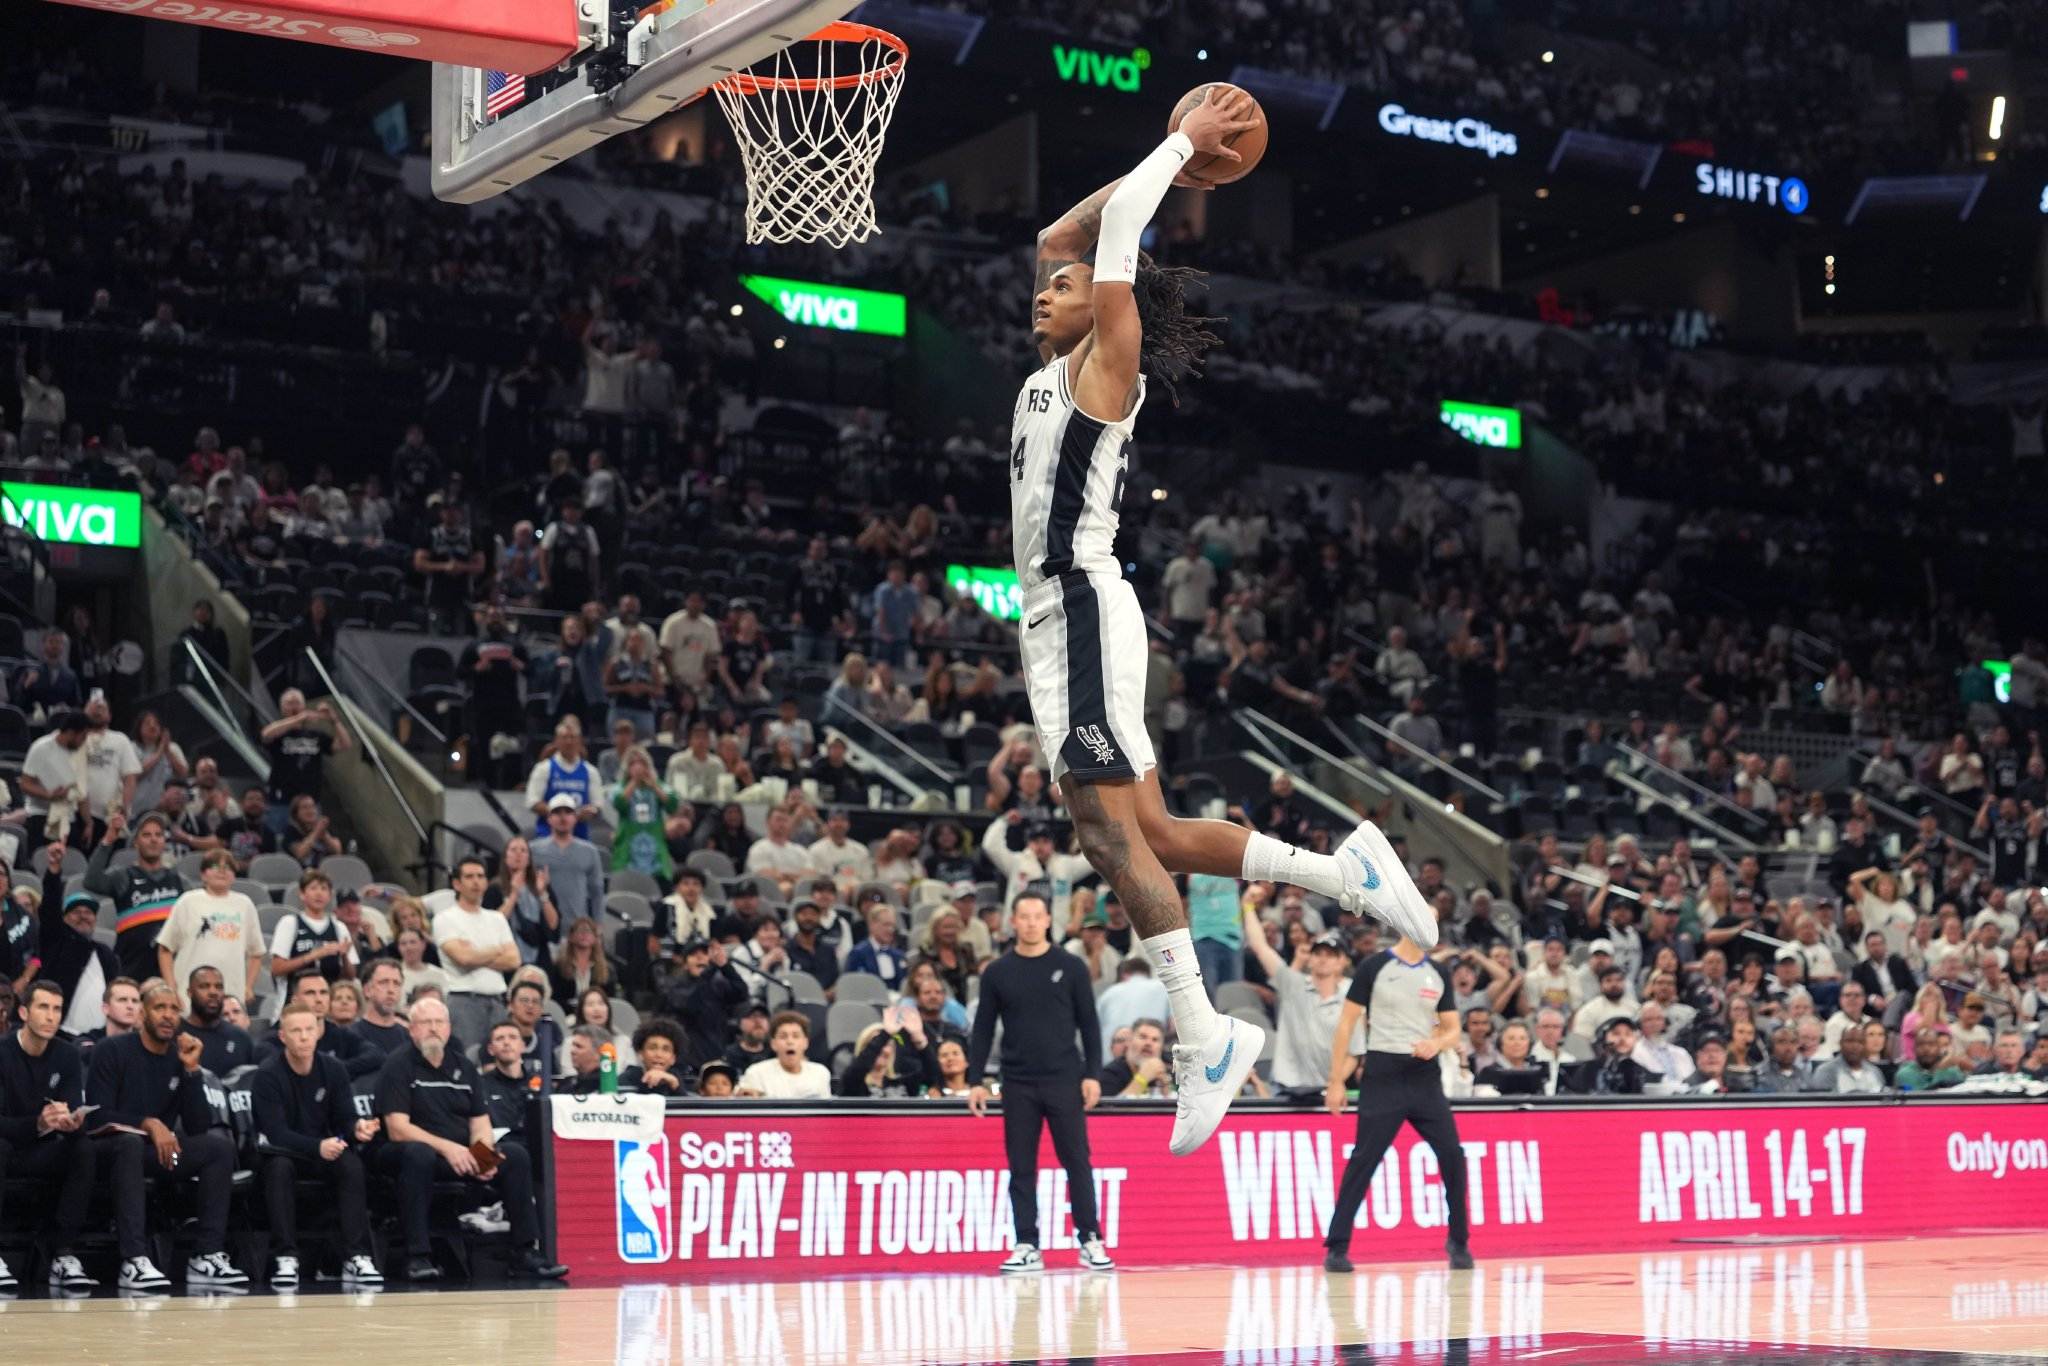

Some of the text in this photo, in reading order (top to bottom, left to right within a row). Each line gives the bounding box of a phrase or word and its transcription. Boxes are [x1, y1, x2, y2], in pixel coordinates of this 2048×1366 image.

[572, 1112, 641, 1126] GATORADE
[679, 1131, 755, 1169] SoFi
[1946, 1130, 2010, 1179] Only
[1218, 1130, 1337, 1241] WIN
[1408, 1140, 1488, 1229] GT
[1495, 1140, 1544, 1225] IN
[1638, 1127, 1867, 1223] APRIL 14-17
[678, 1171, 849, 1260] PLAY-IN
[626, 1231, 652, 1255] NBA
